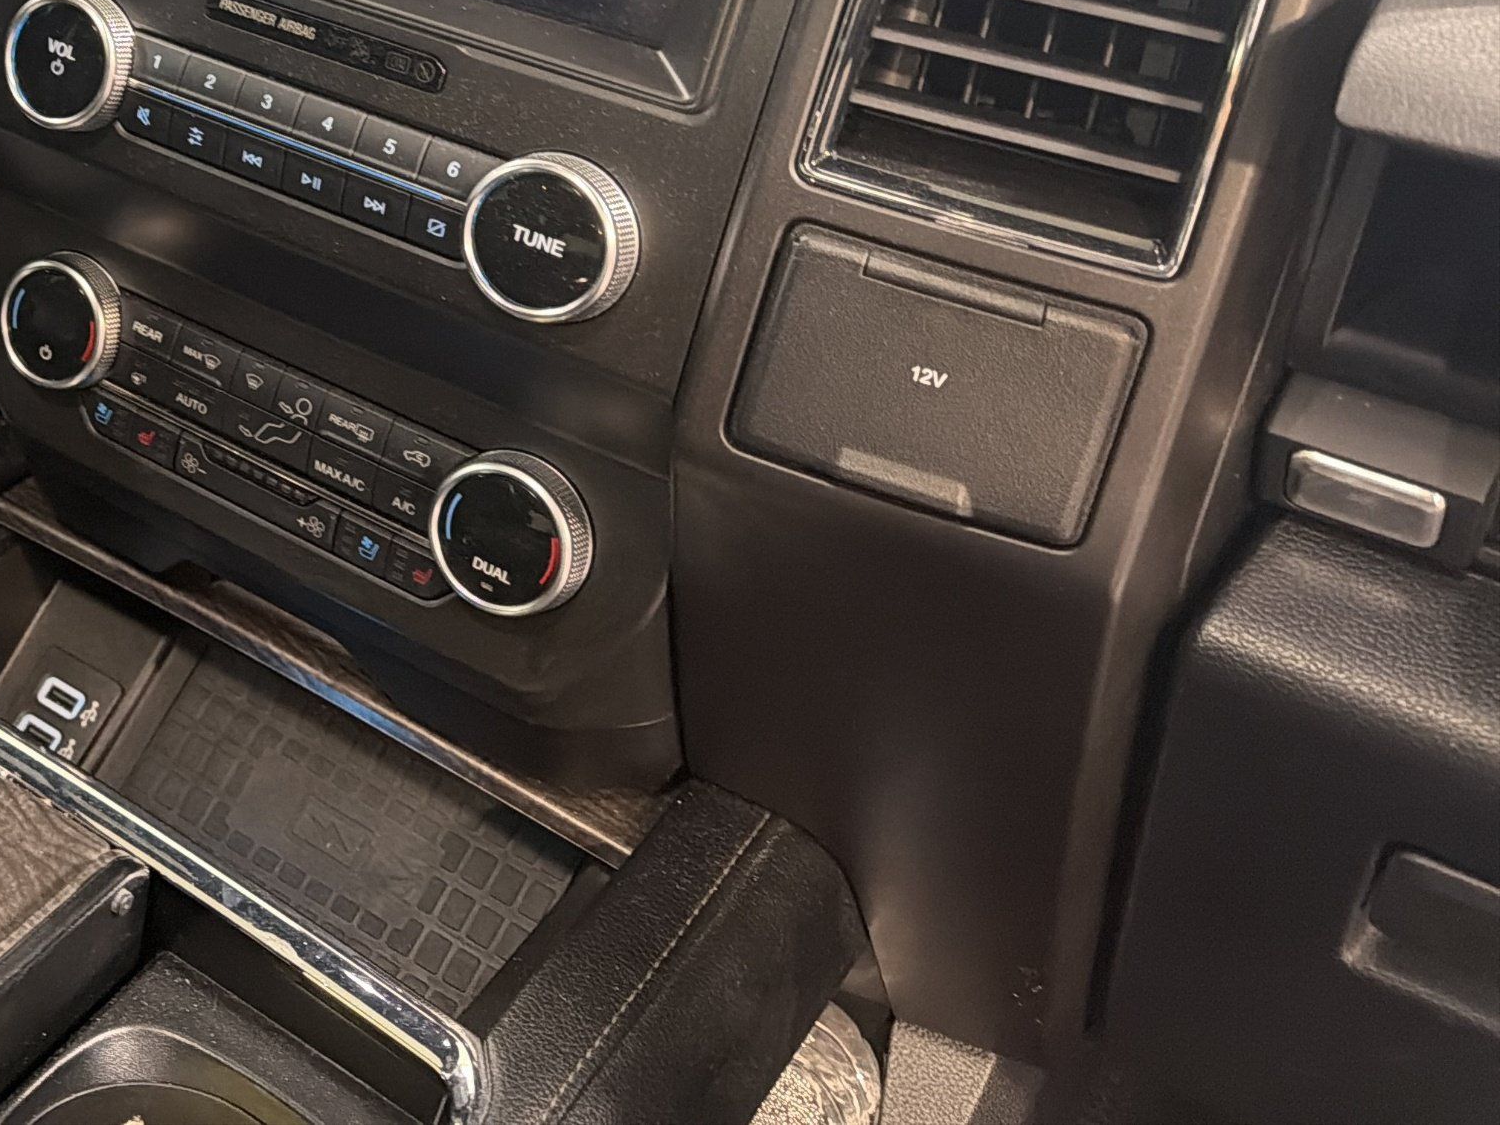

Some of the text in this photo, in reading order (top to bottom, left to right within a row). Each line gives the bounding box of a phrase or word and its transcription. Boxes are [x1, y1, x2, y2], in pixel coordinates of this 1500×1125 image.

[277, 16, 317, 41] AIRBAG
[47, 36, 77, 62] VOL
[152, 53, 163, 70] 1
[203, 73, 217, 90] 2
[260, 93, 274, 111] 3
[321, 116, 335, 132] 4
[382, 137, 398, 155] 5
[446, 160, 462, 178] 6
[512, 223, 568, 258] TUNE
[131, 320, 164, 343] REAR
[910, 365, 949, 389] 12V
[175, 392, 208, 415] AUTO
[390, 496, 416, 516] A/C
[471, 555, 511, 586] DUAL
